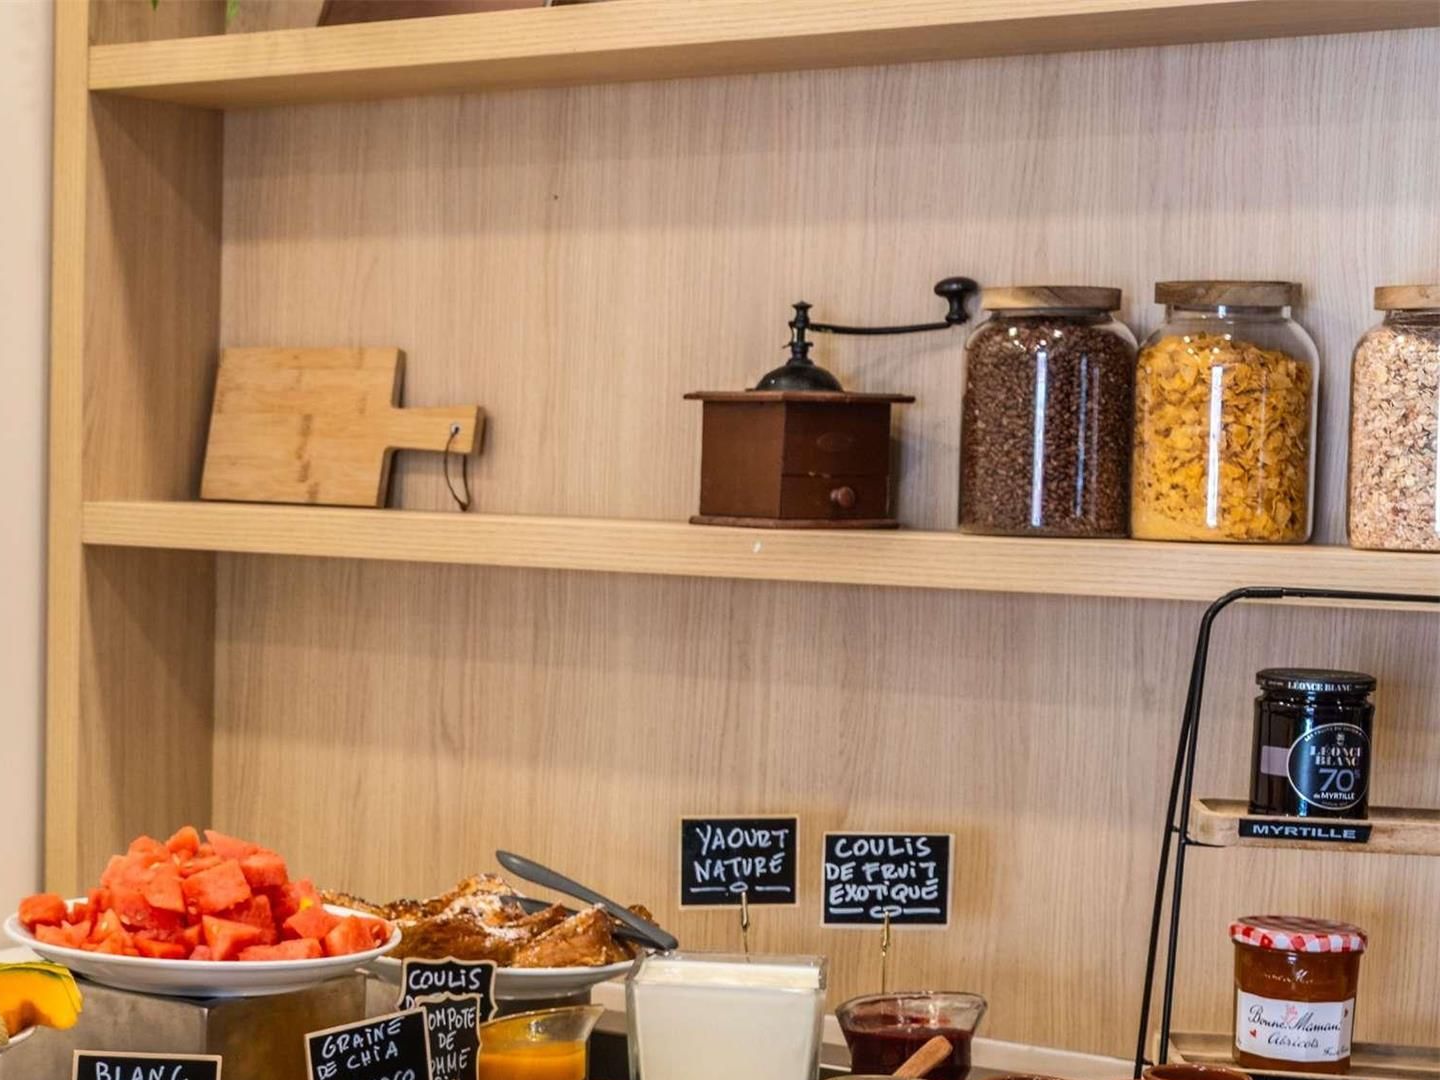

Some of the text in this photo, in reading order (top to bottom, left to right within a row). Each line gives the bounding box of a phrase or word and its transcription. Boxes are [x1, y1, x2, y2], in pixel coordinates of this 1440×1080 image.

[695, 825, 790, 856] YAOURT
[1252, 824, 1357, 839] MYRTILLE
[693, 852, 785, 883] NATURE
[825, 862, 854, 881] DE
[428, 1007, 476, 1031] OMPOTE
[438, 1030, 458, 1051] DE
[317, 1060, 337, 1080] DE
[431, 1047, 471, 1075] OMME
